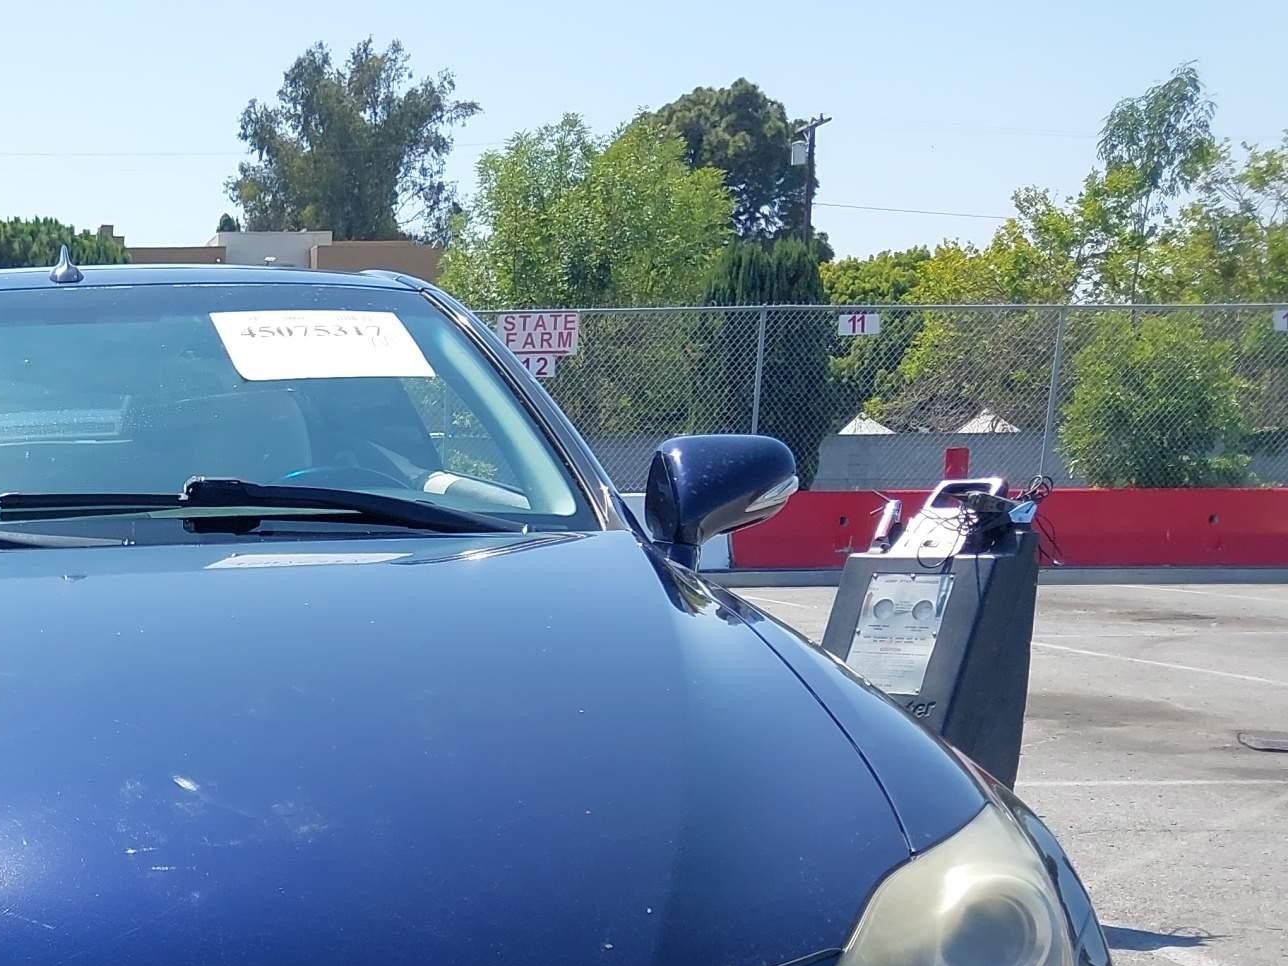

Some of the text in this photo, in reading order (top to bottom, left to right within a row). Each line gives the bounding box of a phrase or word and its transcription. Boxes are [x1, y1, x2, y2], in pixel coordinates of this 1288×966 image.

[503, 313, 577, 332] STATE
[847, 314, 866, 334] 11
[505, 331, 573, 349] FARM
